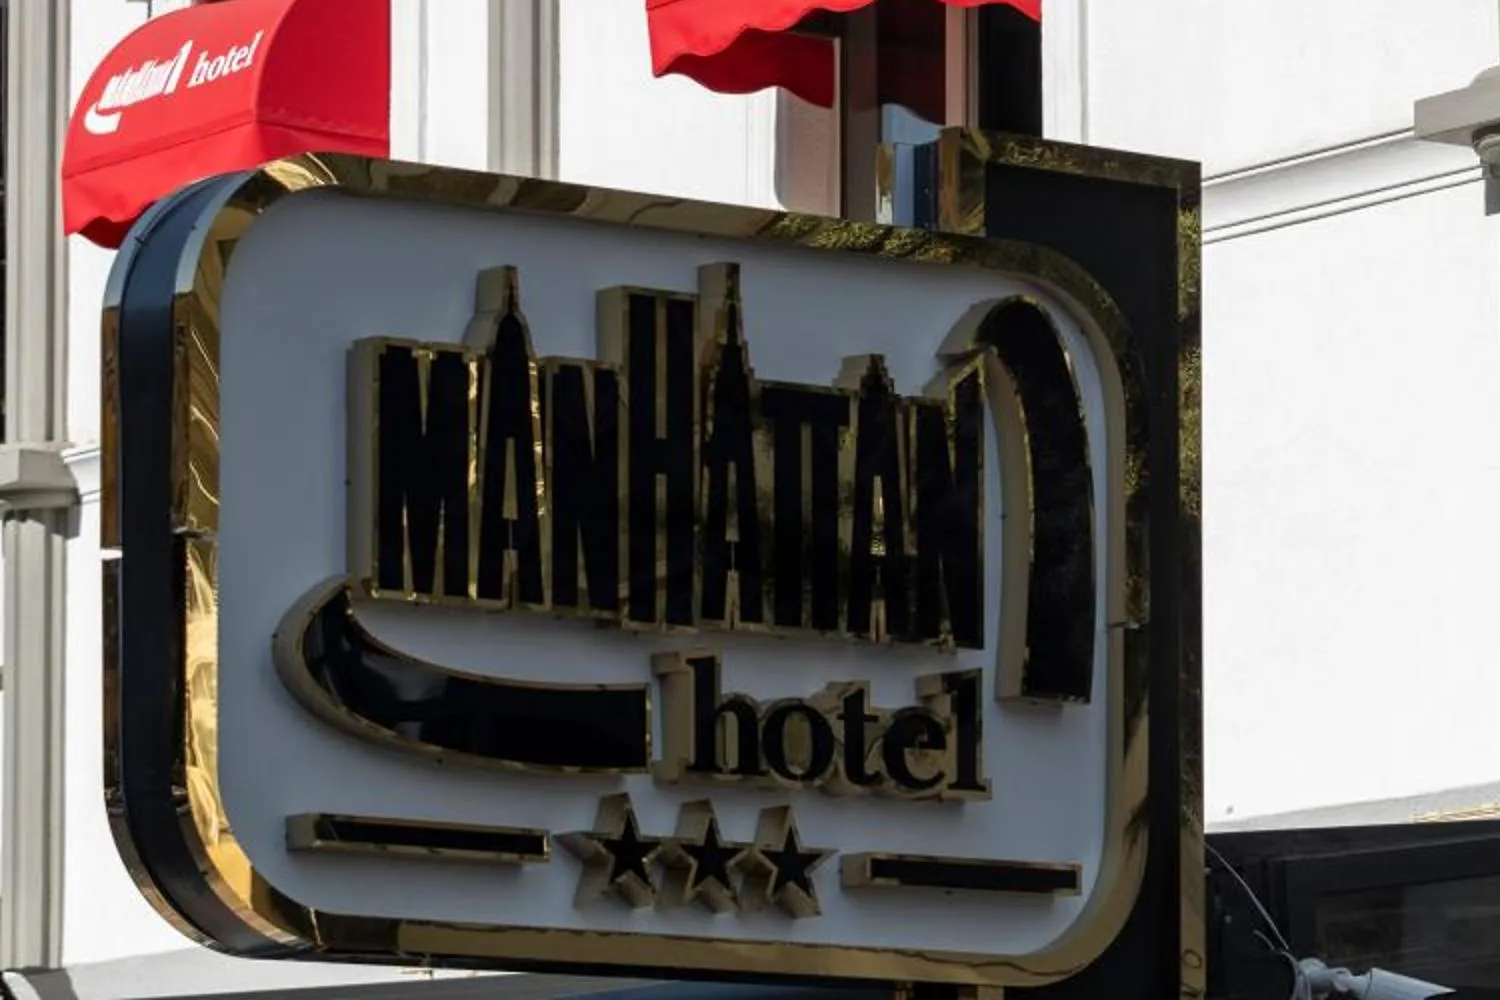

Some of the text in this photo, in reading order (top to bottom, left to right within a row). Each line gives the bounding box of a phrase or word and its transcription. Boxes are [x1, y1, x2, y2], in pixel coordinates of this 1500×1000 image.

[187, 30, 264, 88] hotel
[364, 264, 984, 651] MANHATTAN
[684, 655, 988, 793] hotel
